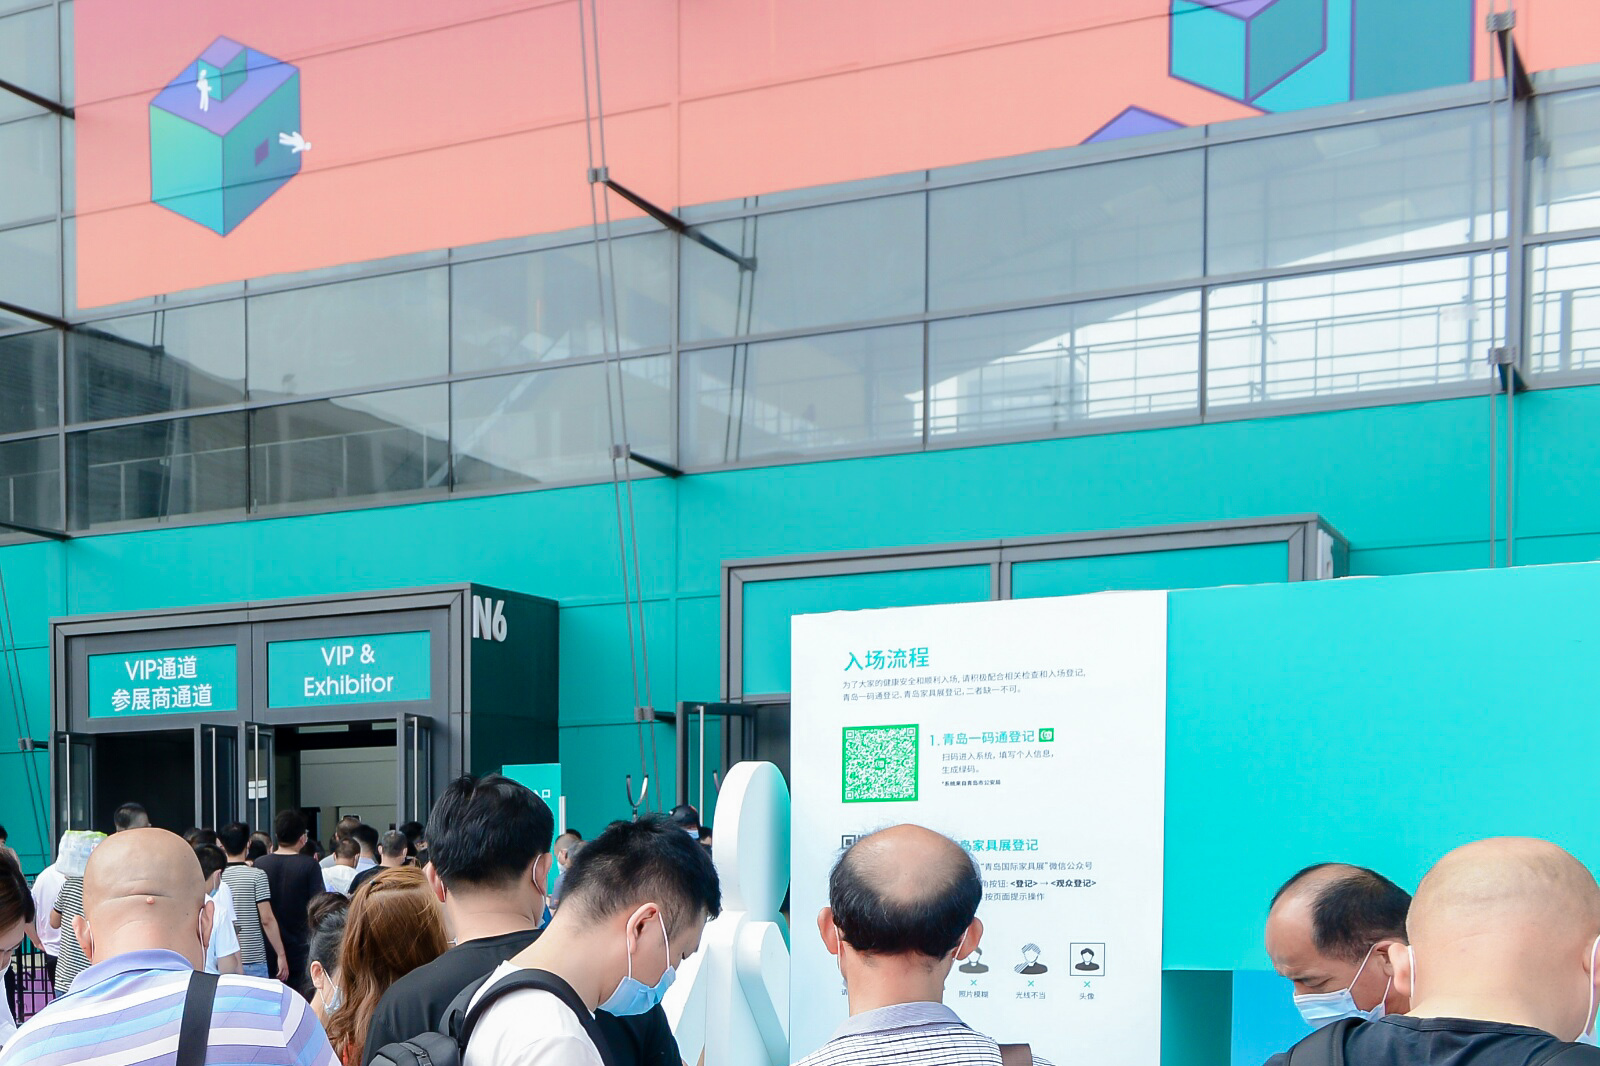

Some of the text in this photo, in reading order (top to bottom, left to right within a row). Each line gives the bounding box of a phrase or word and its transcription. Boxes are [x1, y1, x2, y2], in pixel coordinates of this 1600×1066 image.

[473, 595, 507, 642] N6
[321, 643, 376, 666] VIP &
[844, 647, 930, 671] 入场流程
[125, 655, 198, 680] VIP通道
[304, 673, 394, 697] Exhibitor
[111, 683, 213, 712] 参展商通道
[943, 730, 1035, 746] 青岛一码通登记
[1015, 990, 1046, 1000] 光线不当
[1079, 992, 1095, 1000] 头像
